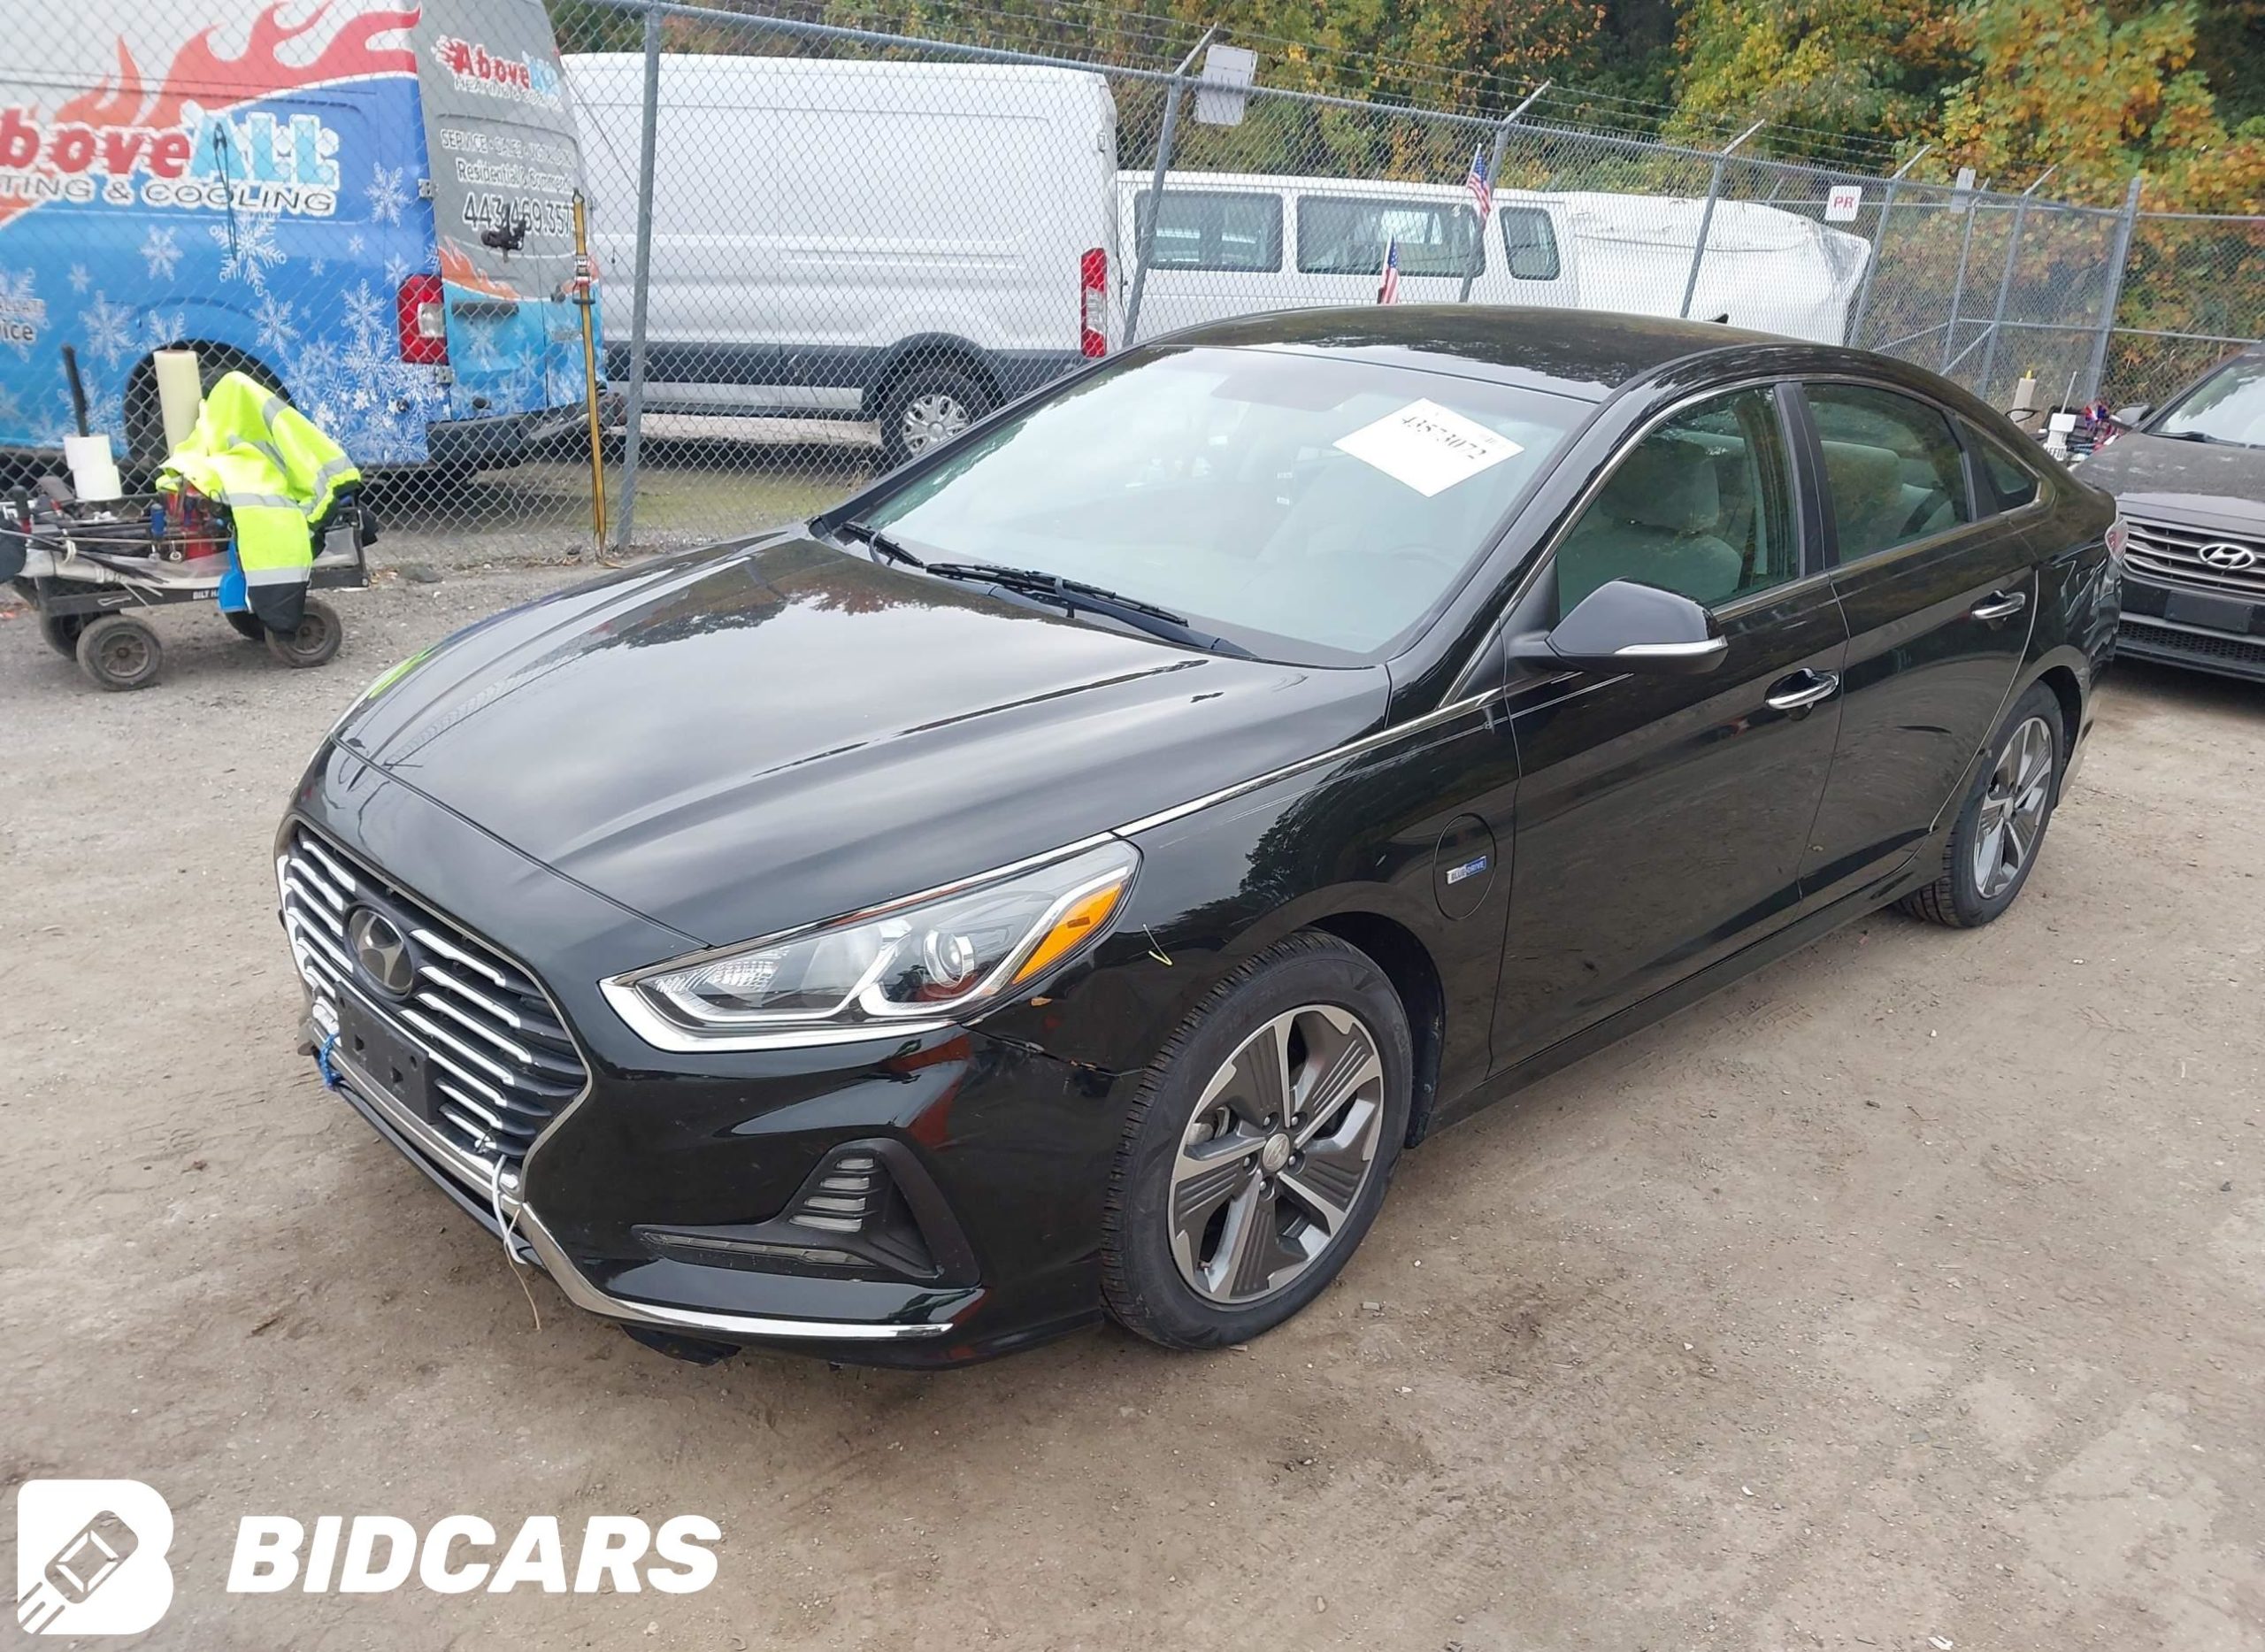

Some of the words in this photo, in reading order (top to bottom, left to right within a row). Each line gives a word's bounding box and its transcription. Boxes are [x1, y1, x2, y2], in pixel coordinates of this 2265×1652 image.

[456, 158, 519, 188] Residential
[107, 181, 131, 200] &
[145, 182, 333, 211] COOLING
